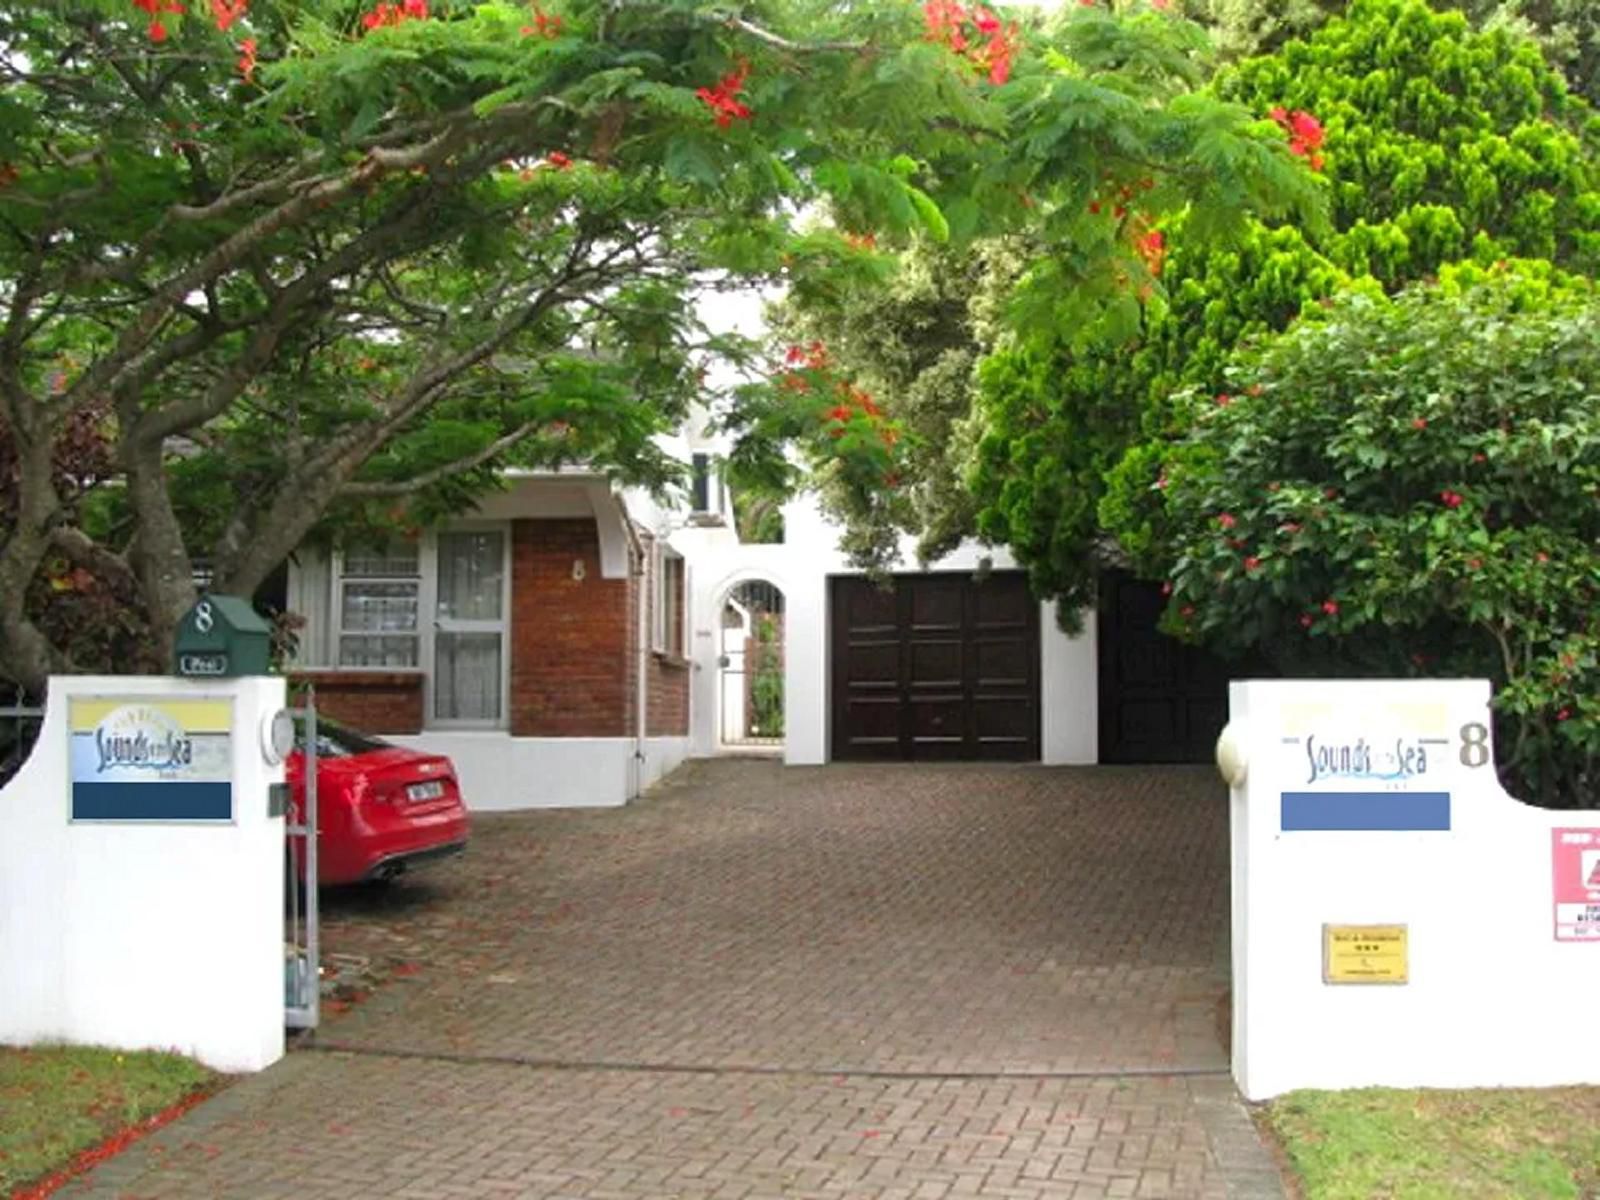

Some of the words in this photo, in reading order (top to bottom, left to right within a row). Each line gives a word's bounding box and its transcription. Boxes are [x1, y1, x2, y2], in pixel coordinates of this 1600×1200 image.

[196, 601, 214, 633] 8
[96, 727, 149, 773] Sounds
[1306, 734, 1371, 784] Sounds
[1396, 737, 1427, 775] Sea
[1459, 721, 1490, 768] 8
